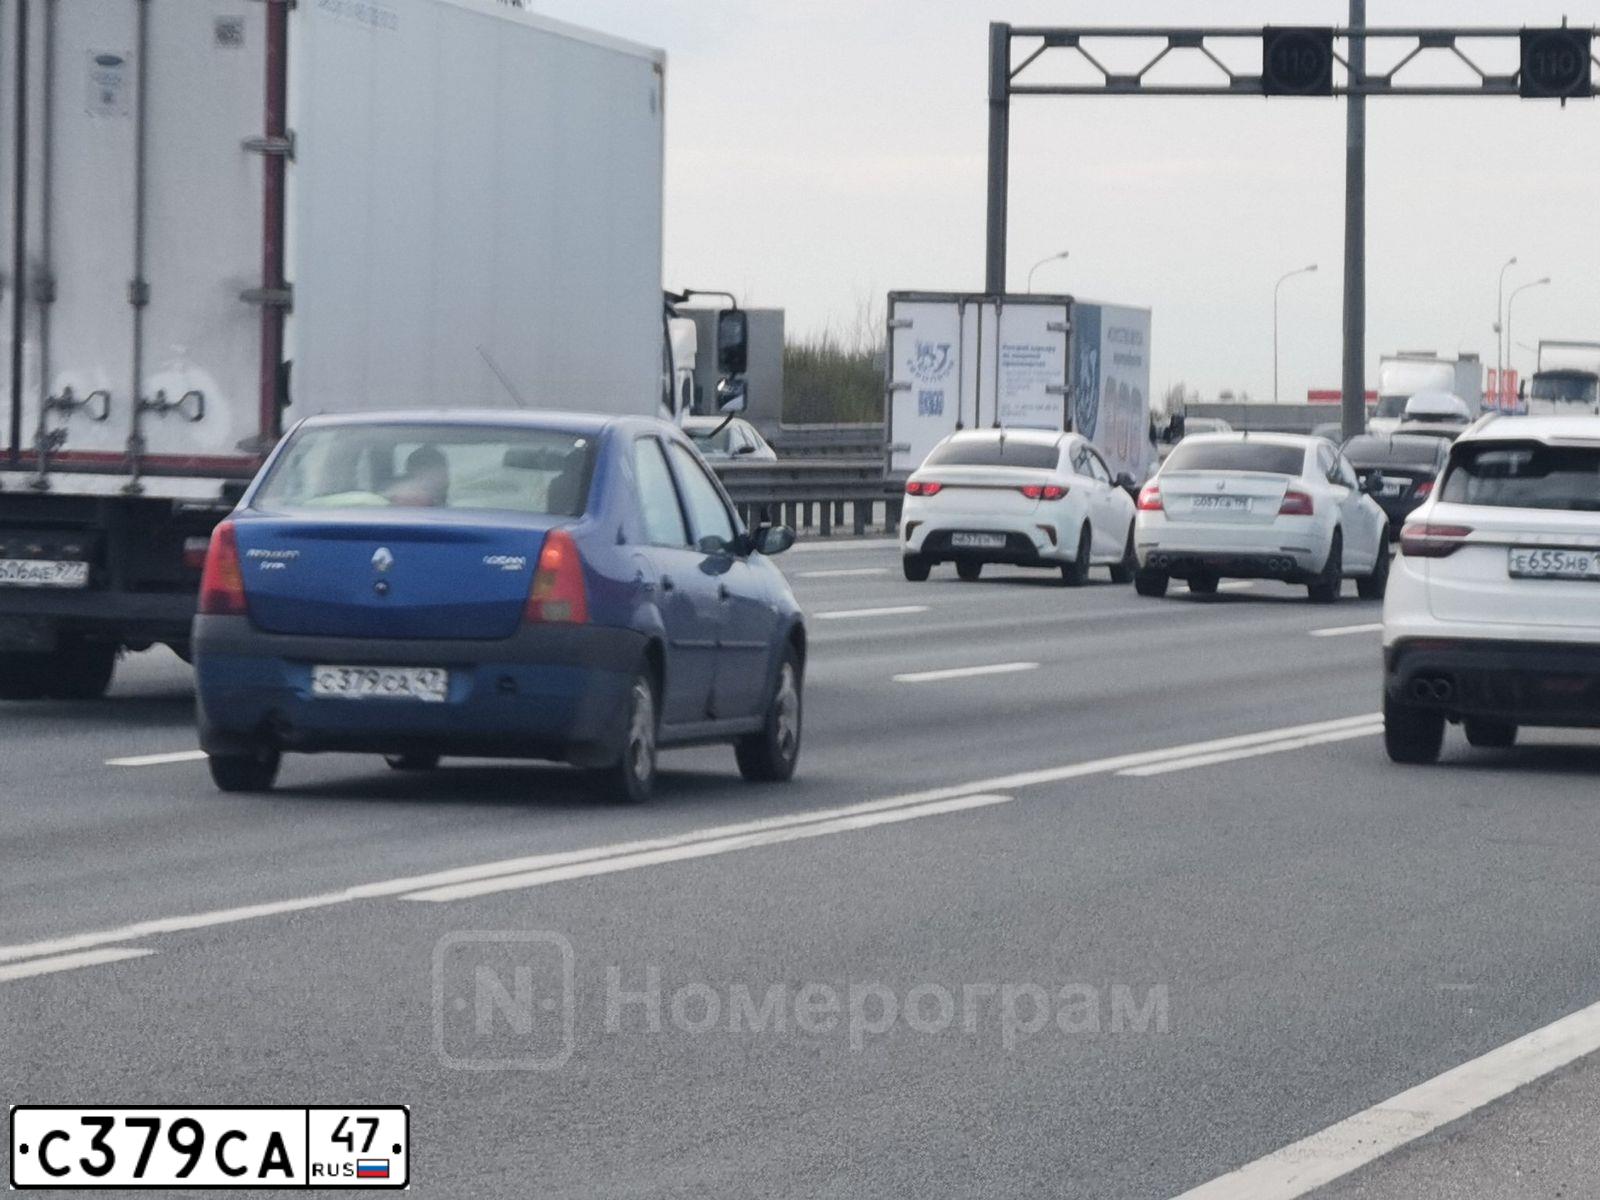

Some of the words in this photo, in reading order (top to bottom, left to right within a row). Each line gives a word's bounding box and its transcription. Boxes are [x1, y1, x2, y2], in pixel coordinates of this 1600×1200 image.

[1278, 47, 1317, 76] 110
[1536, 48, 1575, 77] 110
[1516, 551, 1589, 571] Е655НВ
